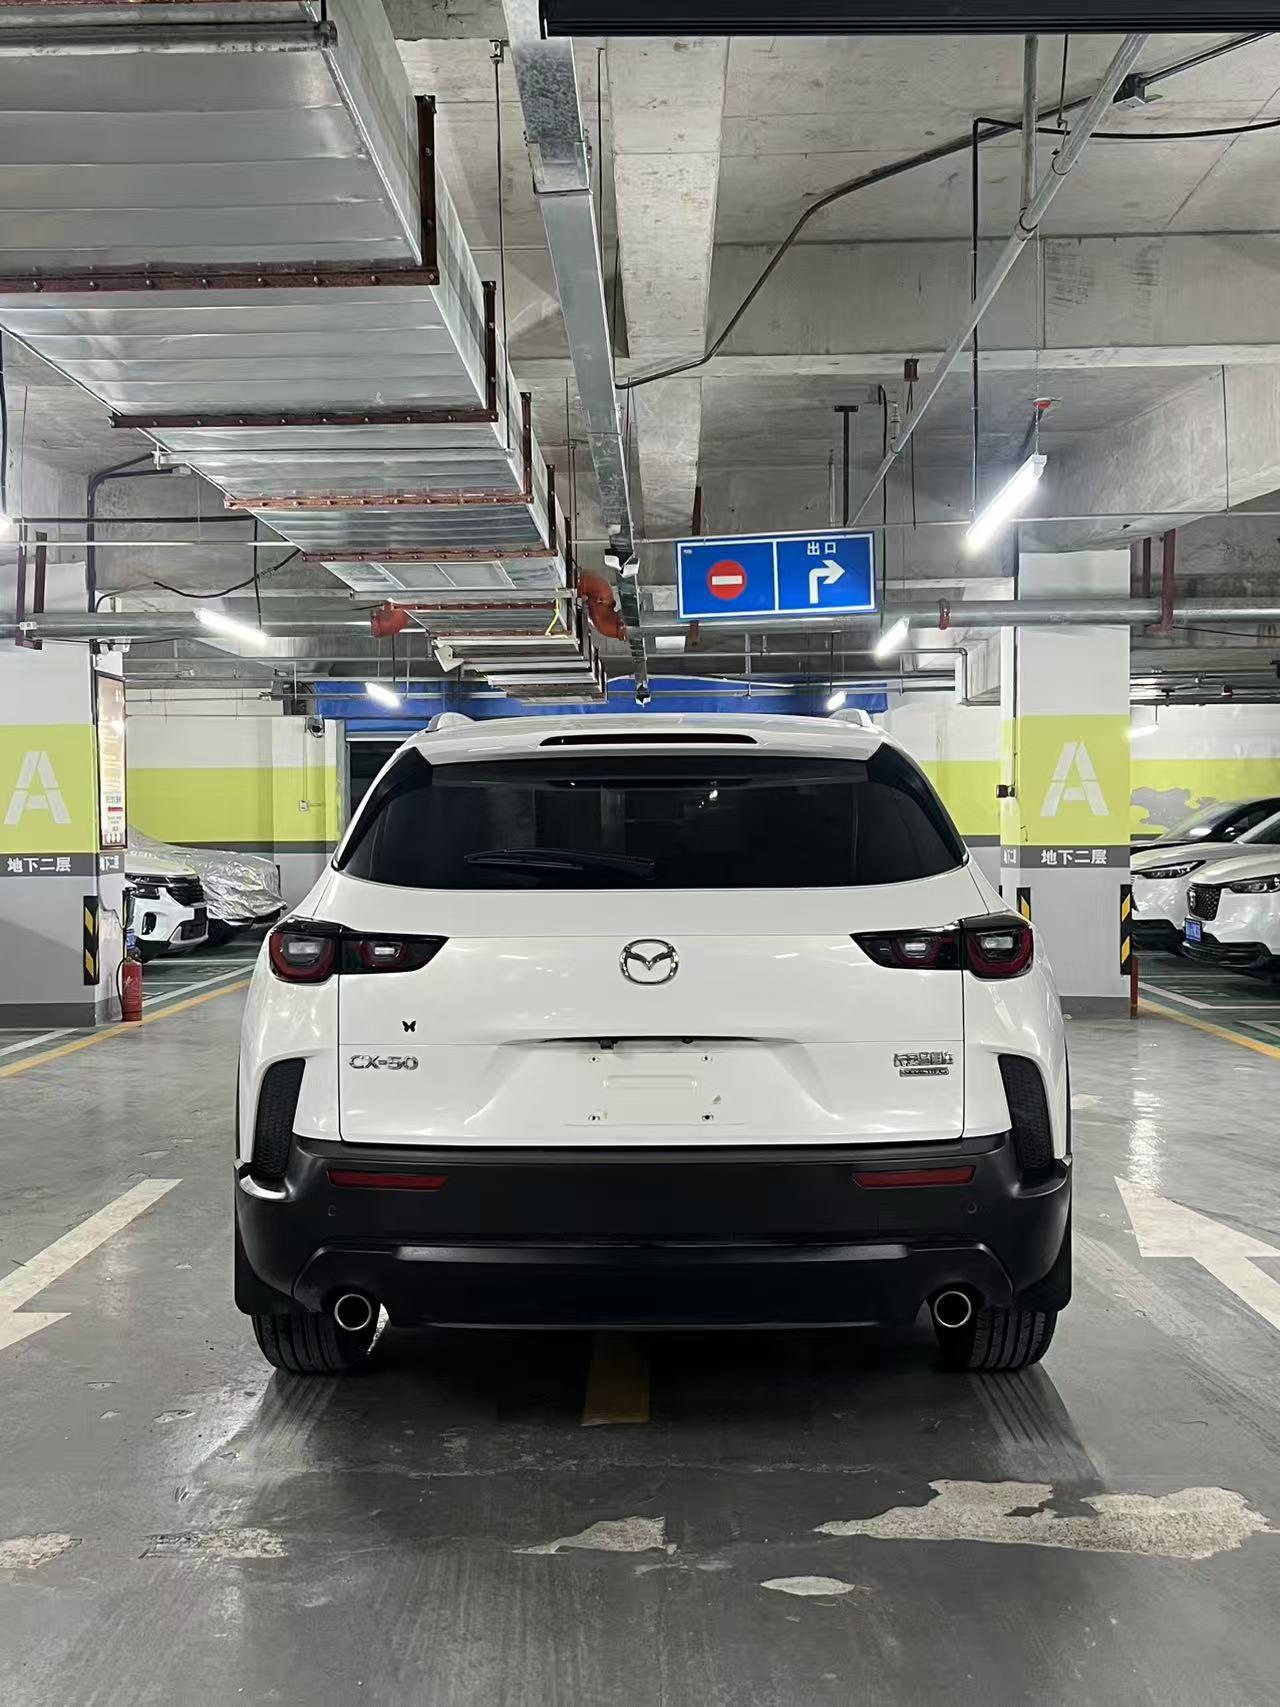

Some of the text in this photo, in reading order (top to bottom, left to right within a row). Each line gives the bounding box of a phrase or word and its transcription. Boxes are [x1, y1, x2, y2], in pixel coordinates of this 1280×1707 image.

[807, 541, 836, 555] 出口
[1040, 741, 1109, 817] A
[3, 750, 72, 825] A
[7, 857, 72, 873] 地下二层
[1041, 849, 1107, 866] 地下二层
[349, 1055, 419, 1071] CX-50
